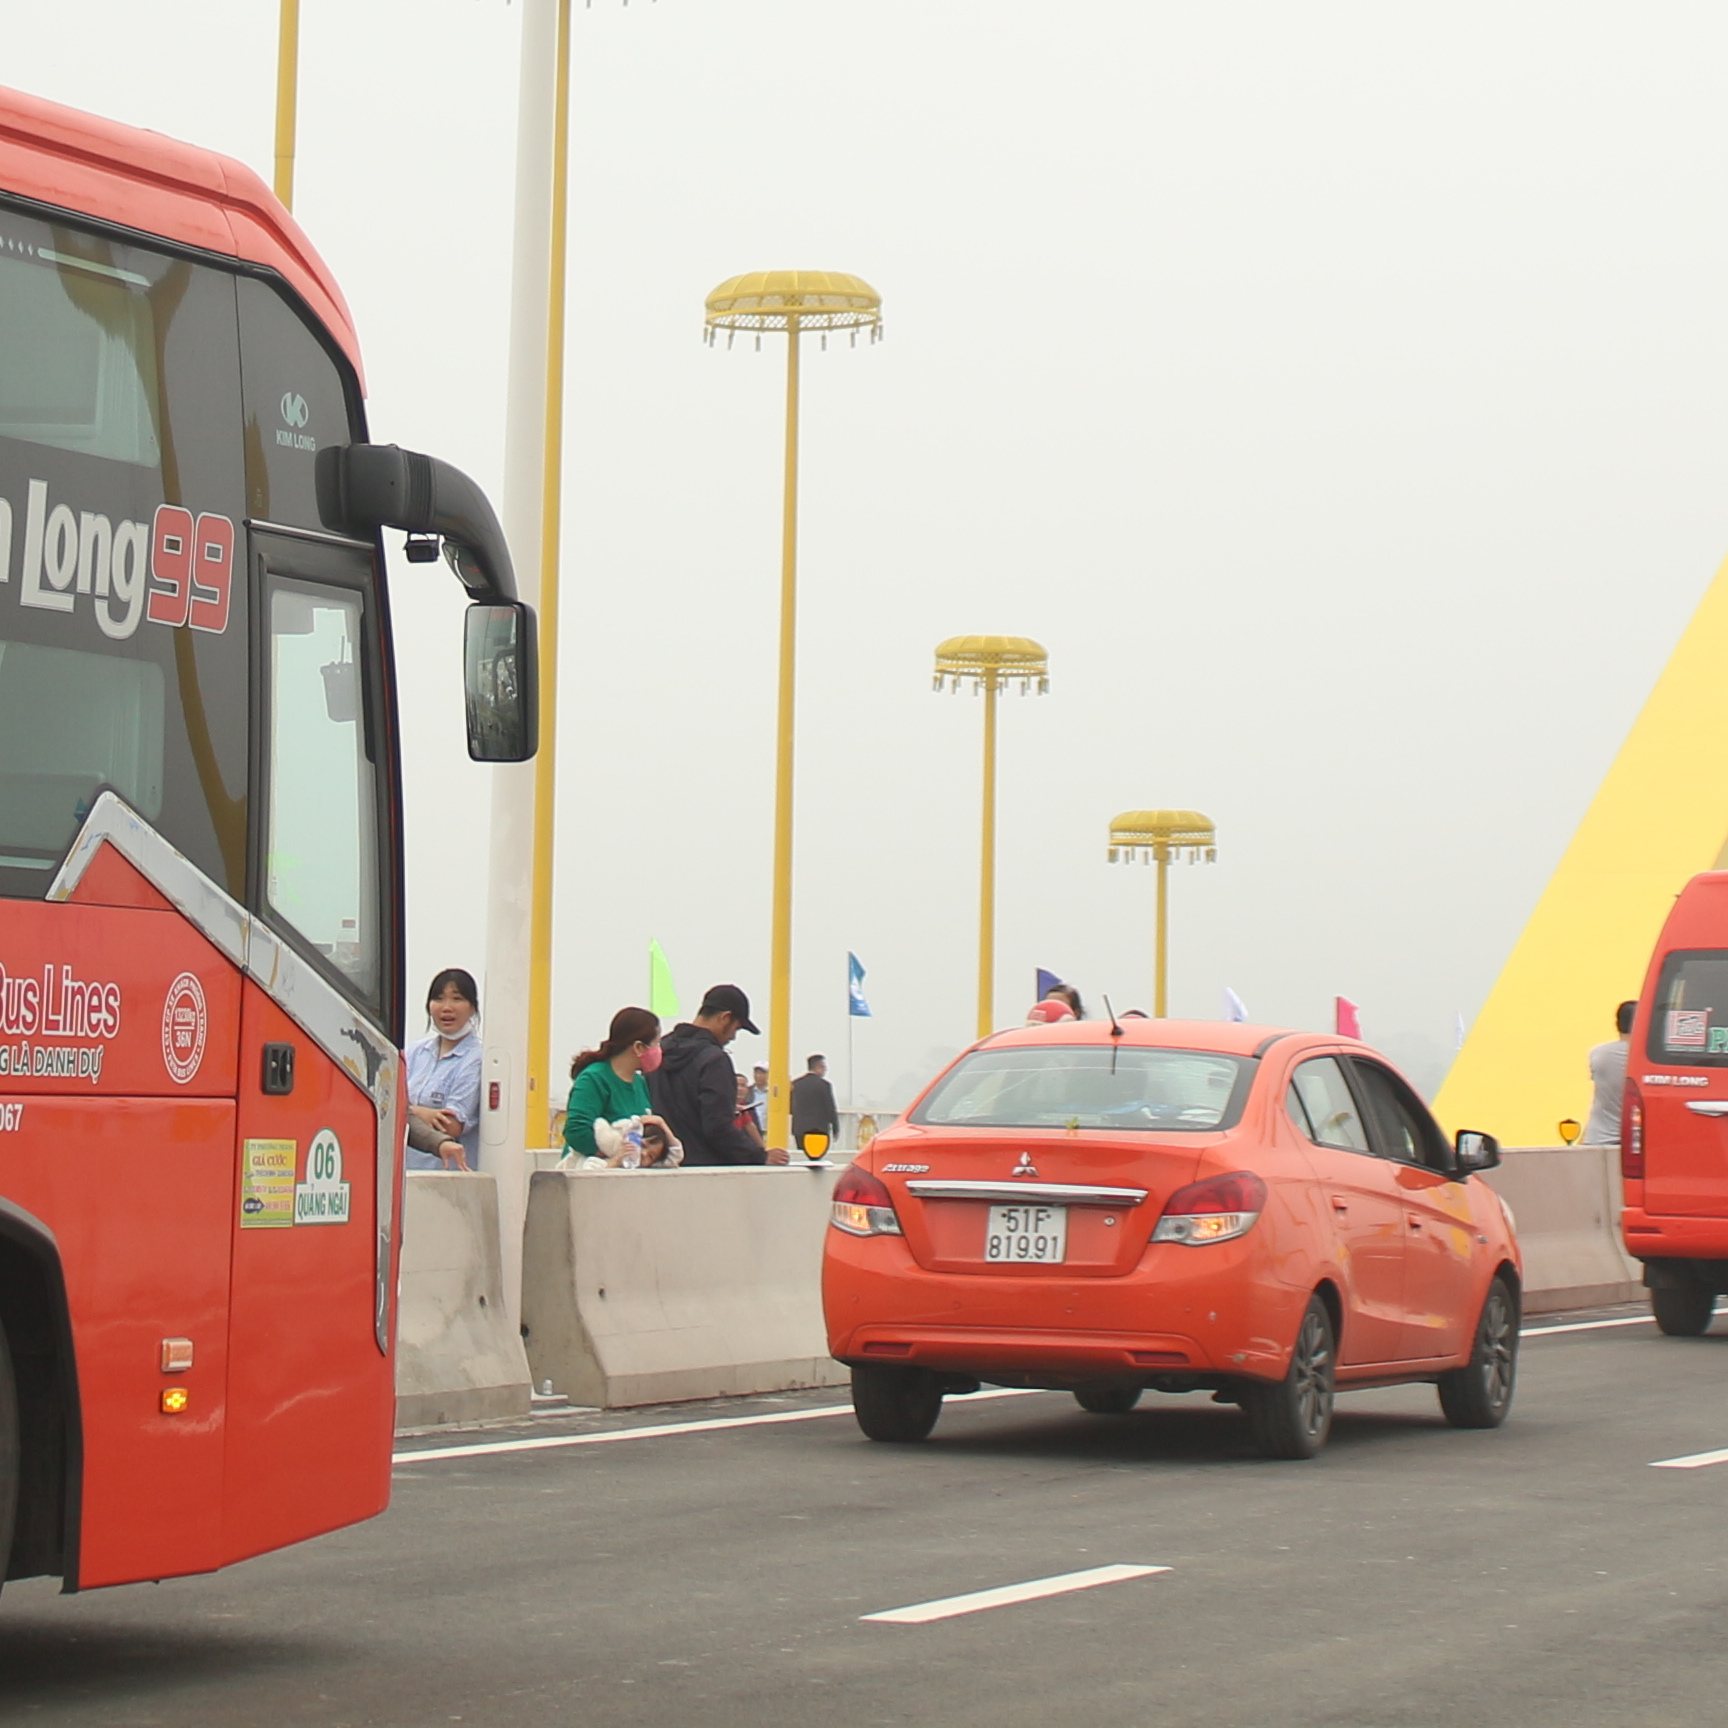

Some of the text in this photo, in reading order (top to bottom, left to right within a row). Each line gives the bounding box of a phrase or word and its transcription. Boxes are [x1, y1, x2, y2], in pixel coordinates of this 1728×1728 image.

[276, 429, 316, 452] KIM LONG
[41, 963, 120, 1039] Lines
[12, 1040, 32, 1076] LÀ
[33, 1046, 77, 1076] DANH
[78, 1044, 105, 1085] DỰ
[1643, 1075, 1709, 1087] KIM LONG
[314, 1142, 335, 1180] 06
[297, 1183, 326, 1221] QUẢNG
[1006, 1208, 1047, 1233] 51F
[988, 1235, 1059, 1260] 819.91
